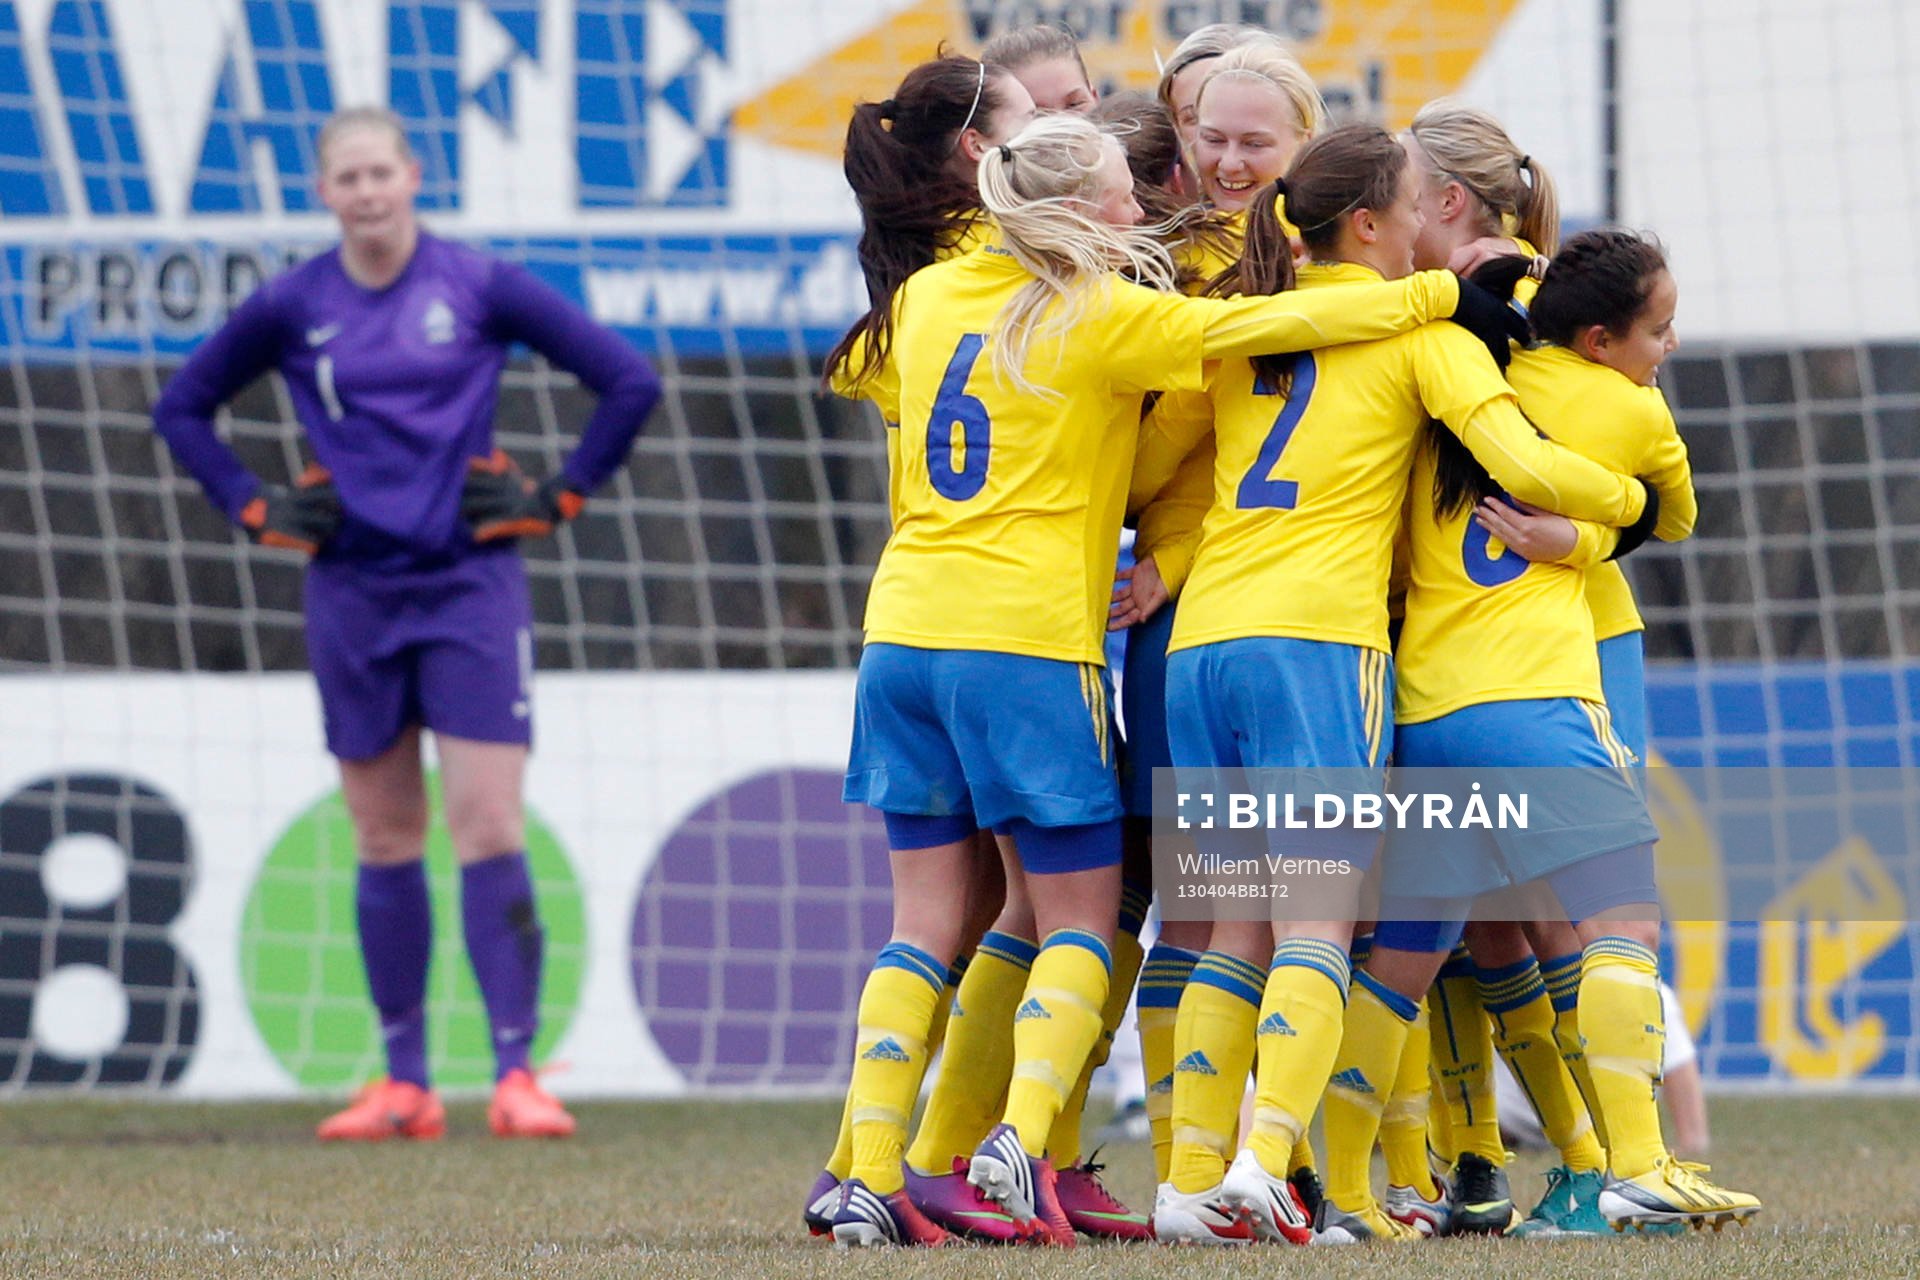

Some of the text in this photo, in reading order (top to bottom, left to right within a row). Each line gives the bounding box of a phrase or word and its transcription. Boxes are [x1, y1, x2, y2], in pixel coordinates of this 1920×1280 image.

[38, 252, 302, 324] PROD
[586, 242, 868, 326] www.d
[315, 354, 345, 423] 1
[926, 333, 990, 501] 6
[1236, 350, 1317, 510] 2
